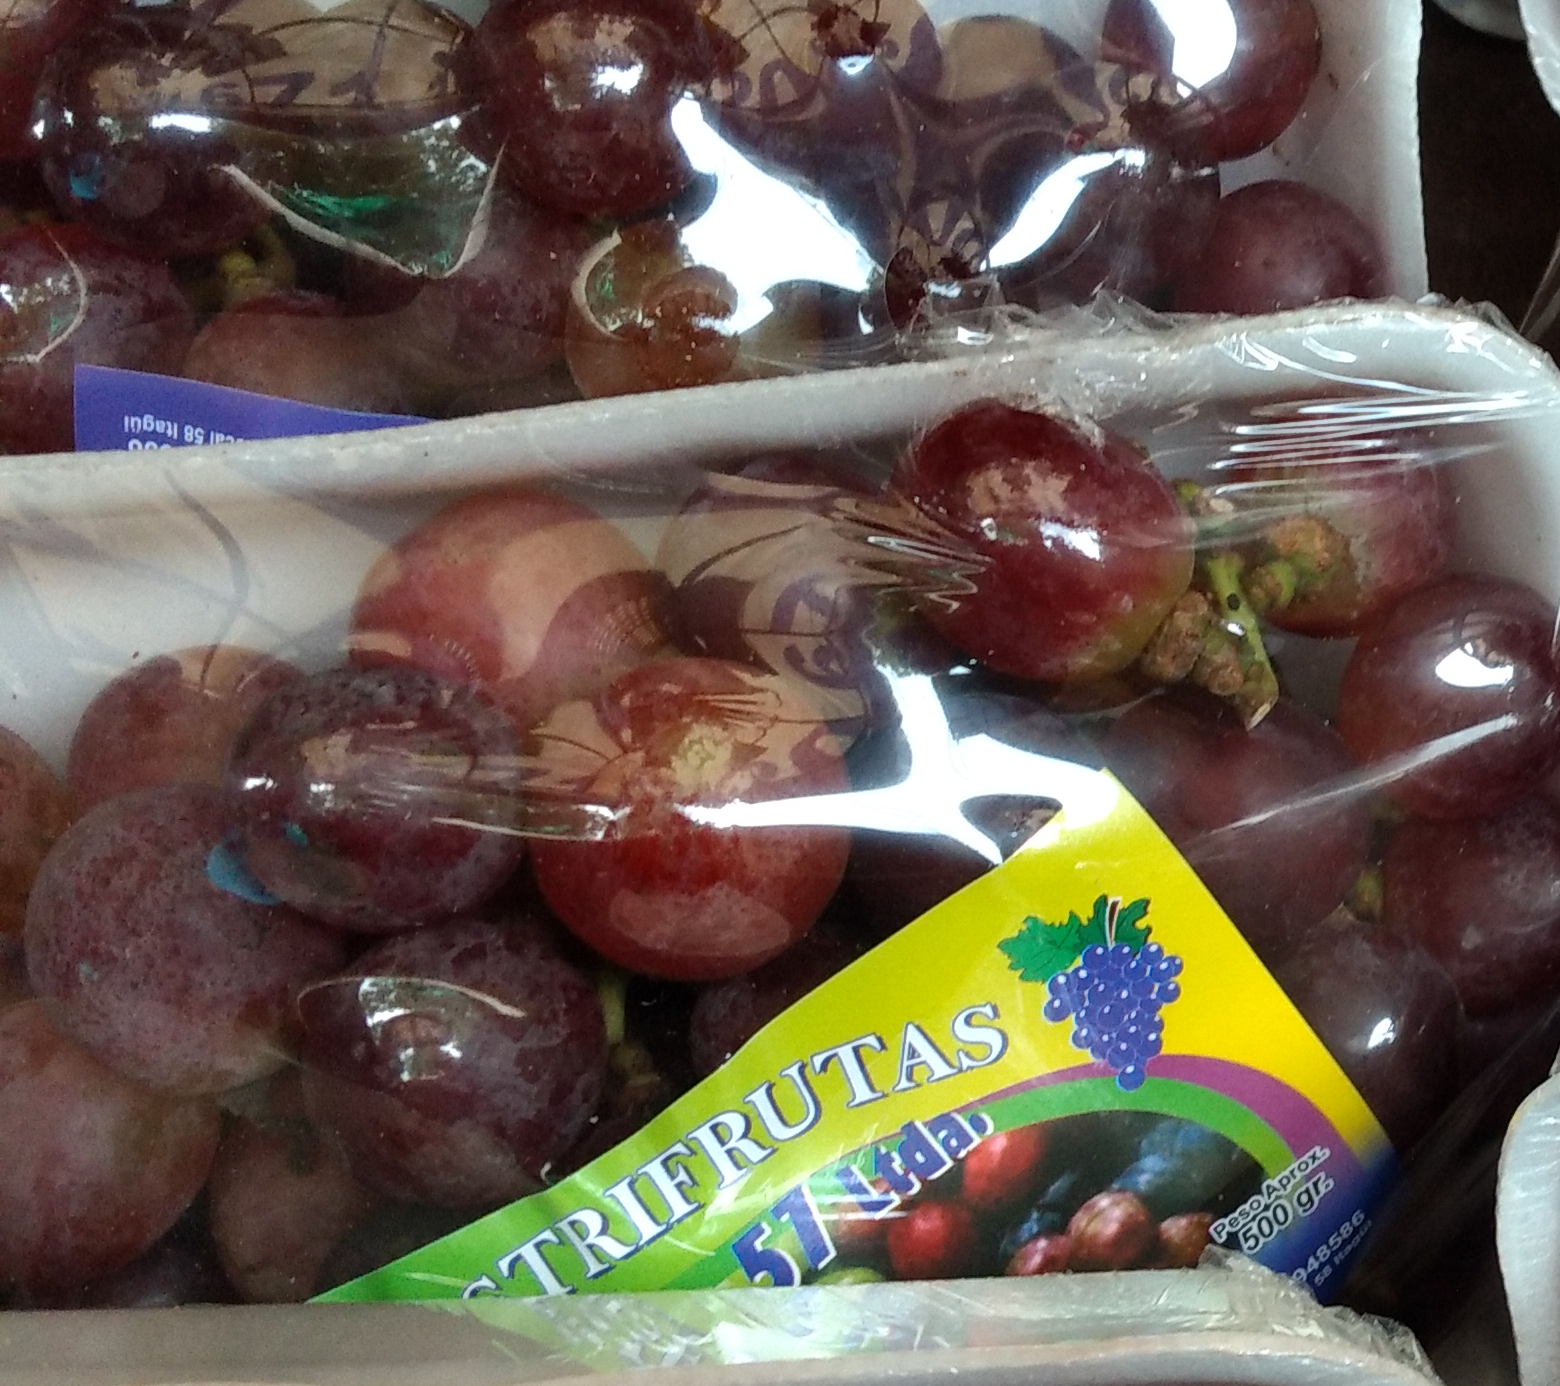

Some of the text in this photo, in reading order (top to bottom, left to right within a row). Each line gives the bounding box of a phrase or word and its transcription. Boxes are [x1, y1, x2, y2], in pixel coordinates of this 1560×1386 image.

[730, 1110, 995, 1288] 57 Ltda.
[1208, 1145, 1331, 1243] Peso Aprox.
[1238, 1171, 1335, 1255] 500 gr.
[1283, 1209, 1366, 1282] 948586
